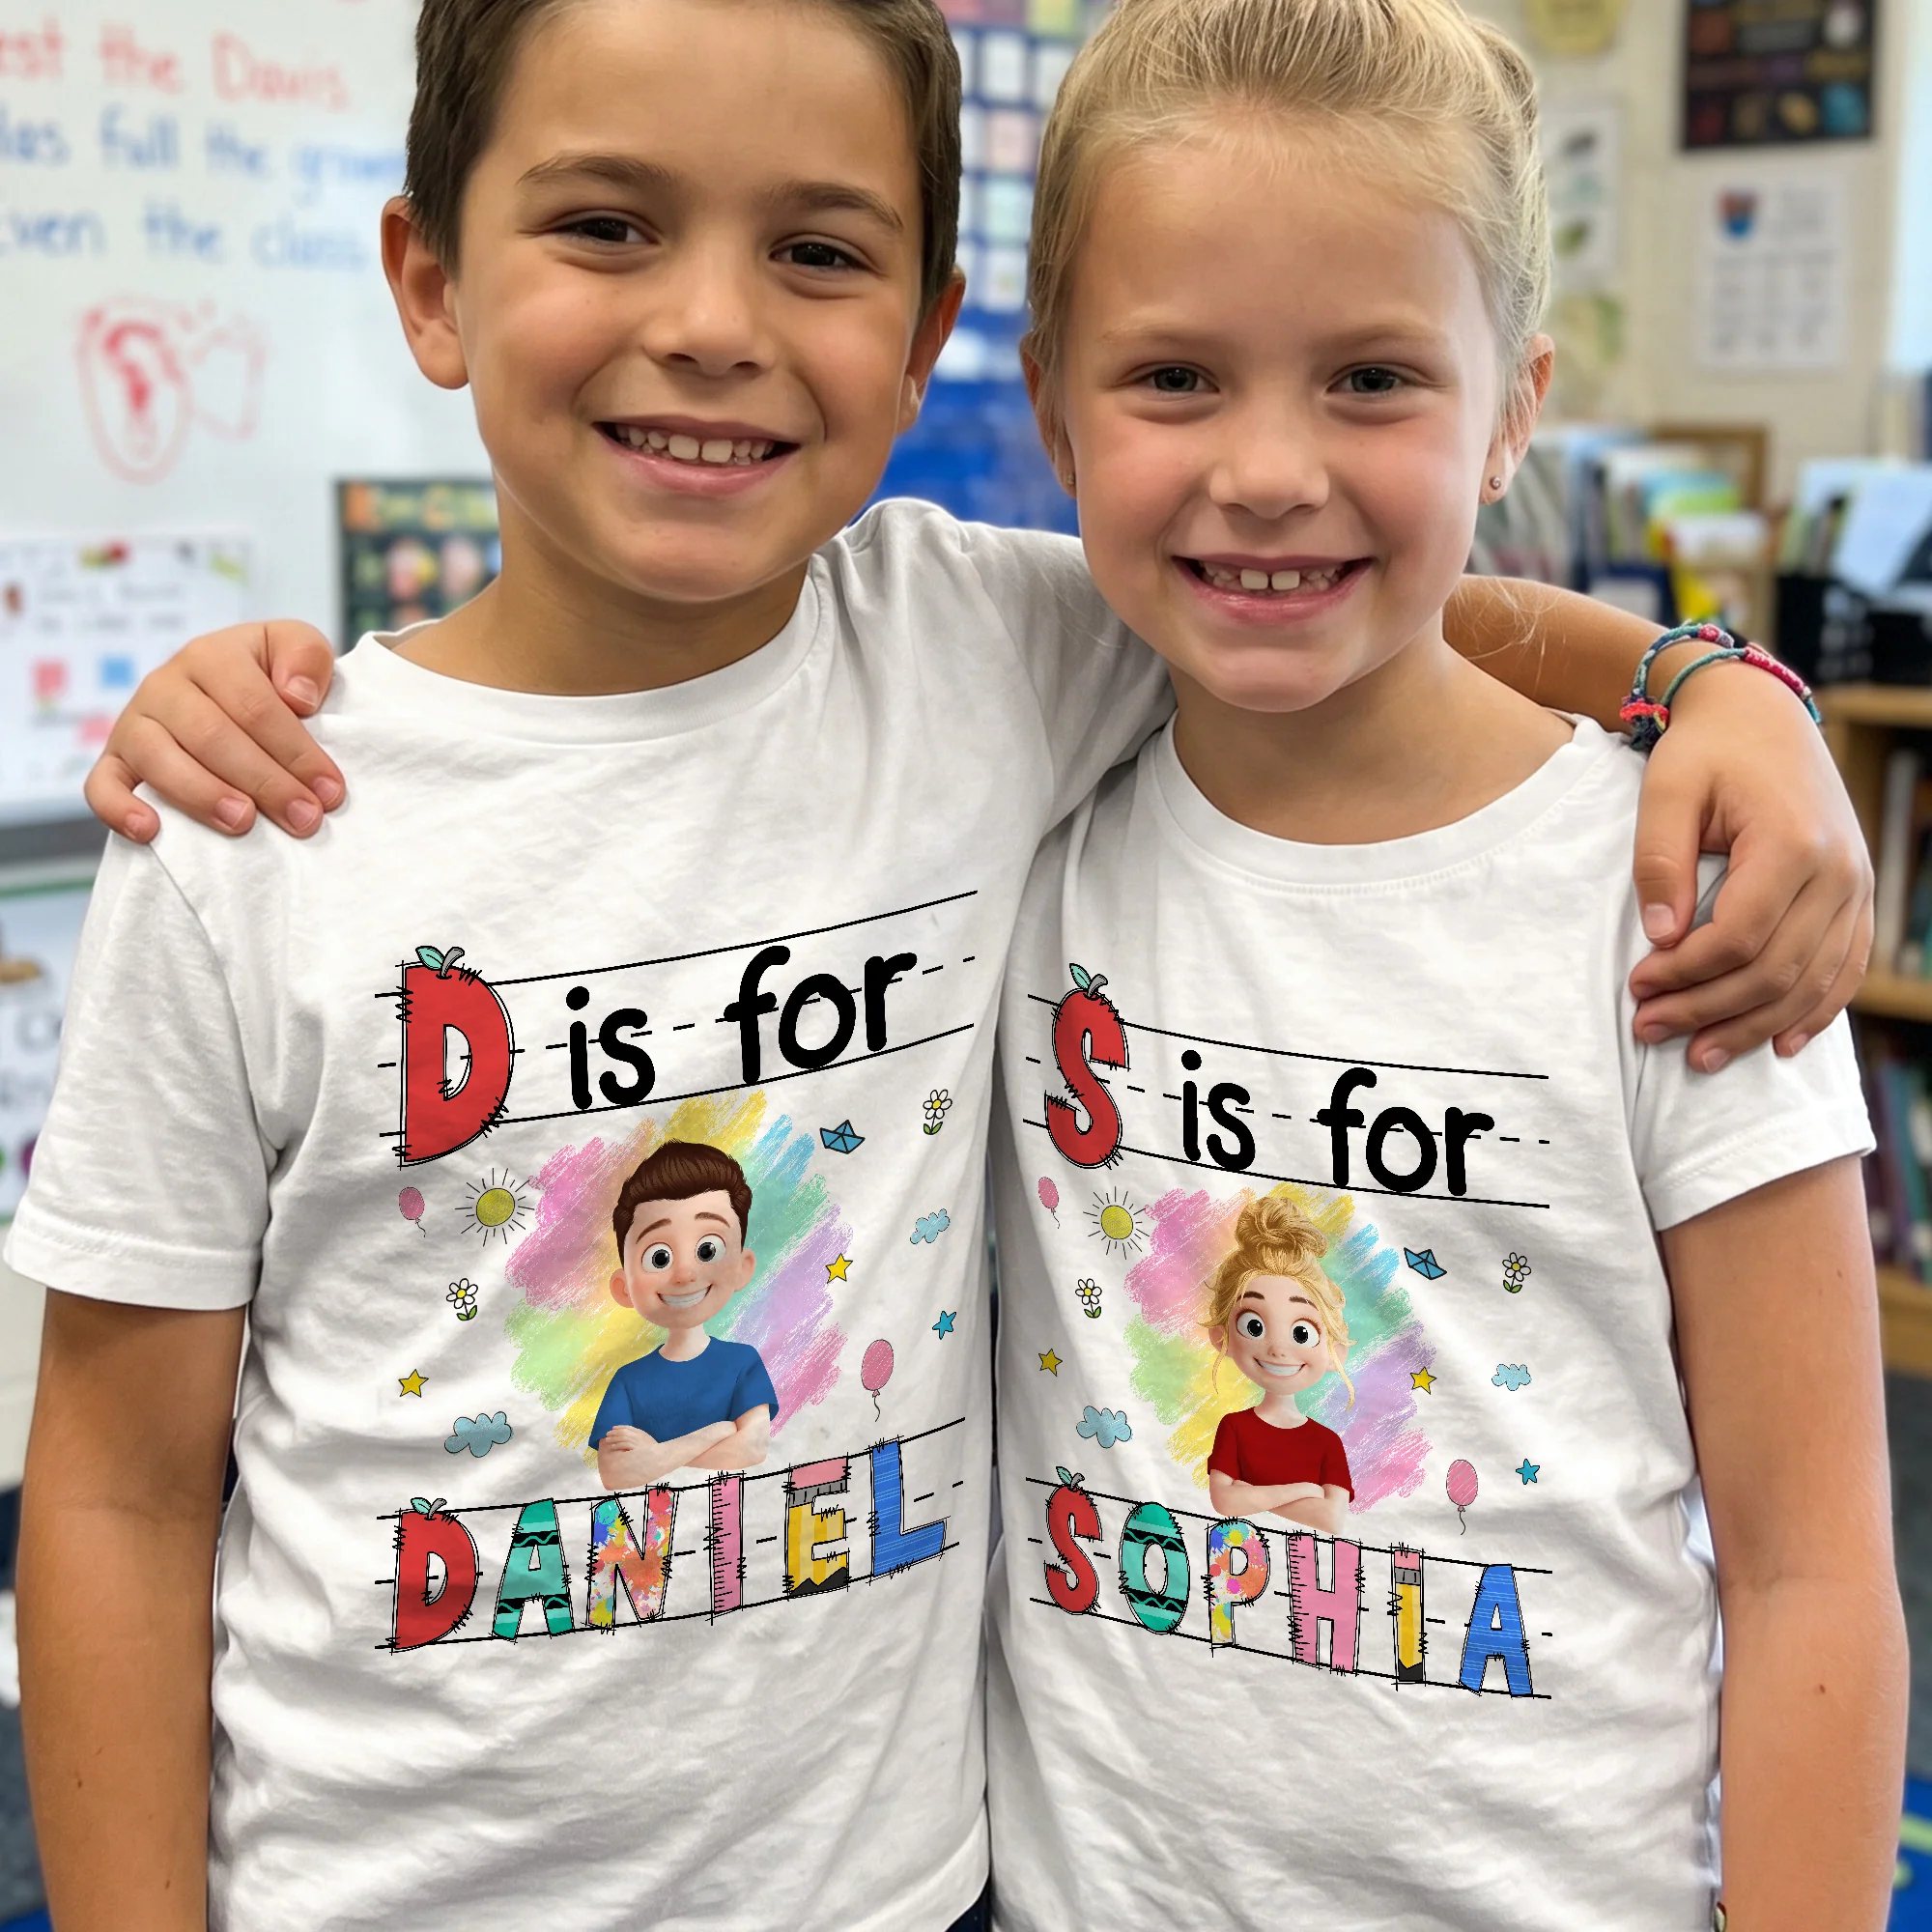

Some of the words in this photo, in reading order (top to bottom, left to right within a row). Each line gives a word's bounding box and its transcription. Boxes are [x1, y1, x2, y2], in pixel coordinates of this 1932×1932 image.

[99, 22, 184, 96] the
[143, 196, 224, 261] the
[397, 946, 515, 1169] D
[565, 985, 656, 1111] is
[723, 945, 919, 1085] for
[1044, 963, 1130, 1170] S
[1180, 1049, 1257, 1172] is
[1316, 1066, 1496, 1197] for
[390, 1435, 948, 1655] DANIEL
[1043, 1466, 1535, 1698] SOPHIA
